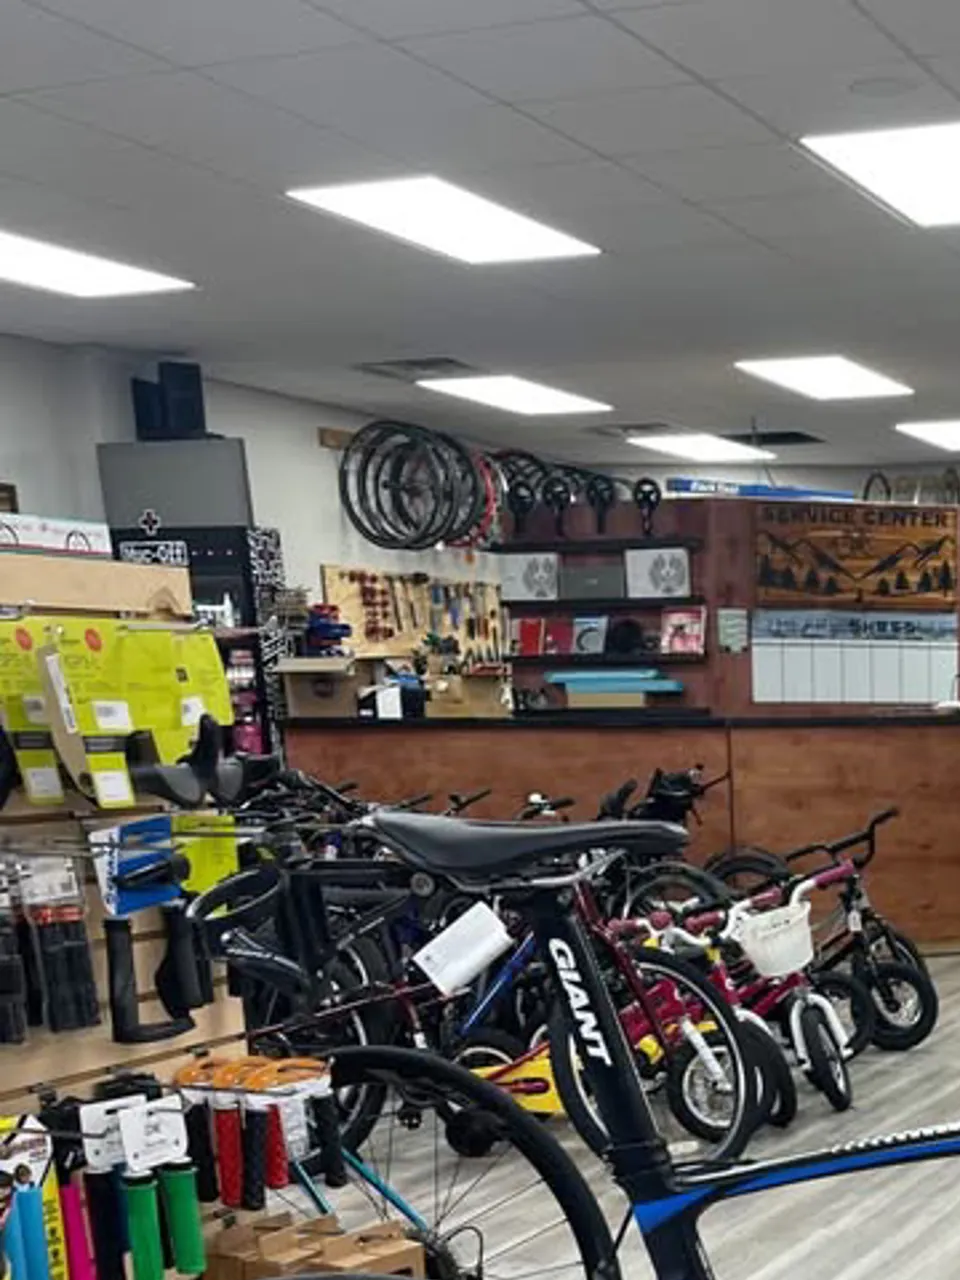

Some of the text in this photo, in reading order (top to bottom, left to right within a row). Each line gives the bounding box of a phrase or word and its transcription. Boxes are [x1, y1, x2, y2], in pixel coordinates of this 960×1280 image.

[761, 506, 949, 527] SERVICE CENTER
[549, 938, 613, 1066] GIANT
